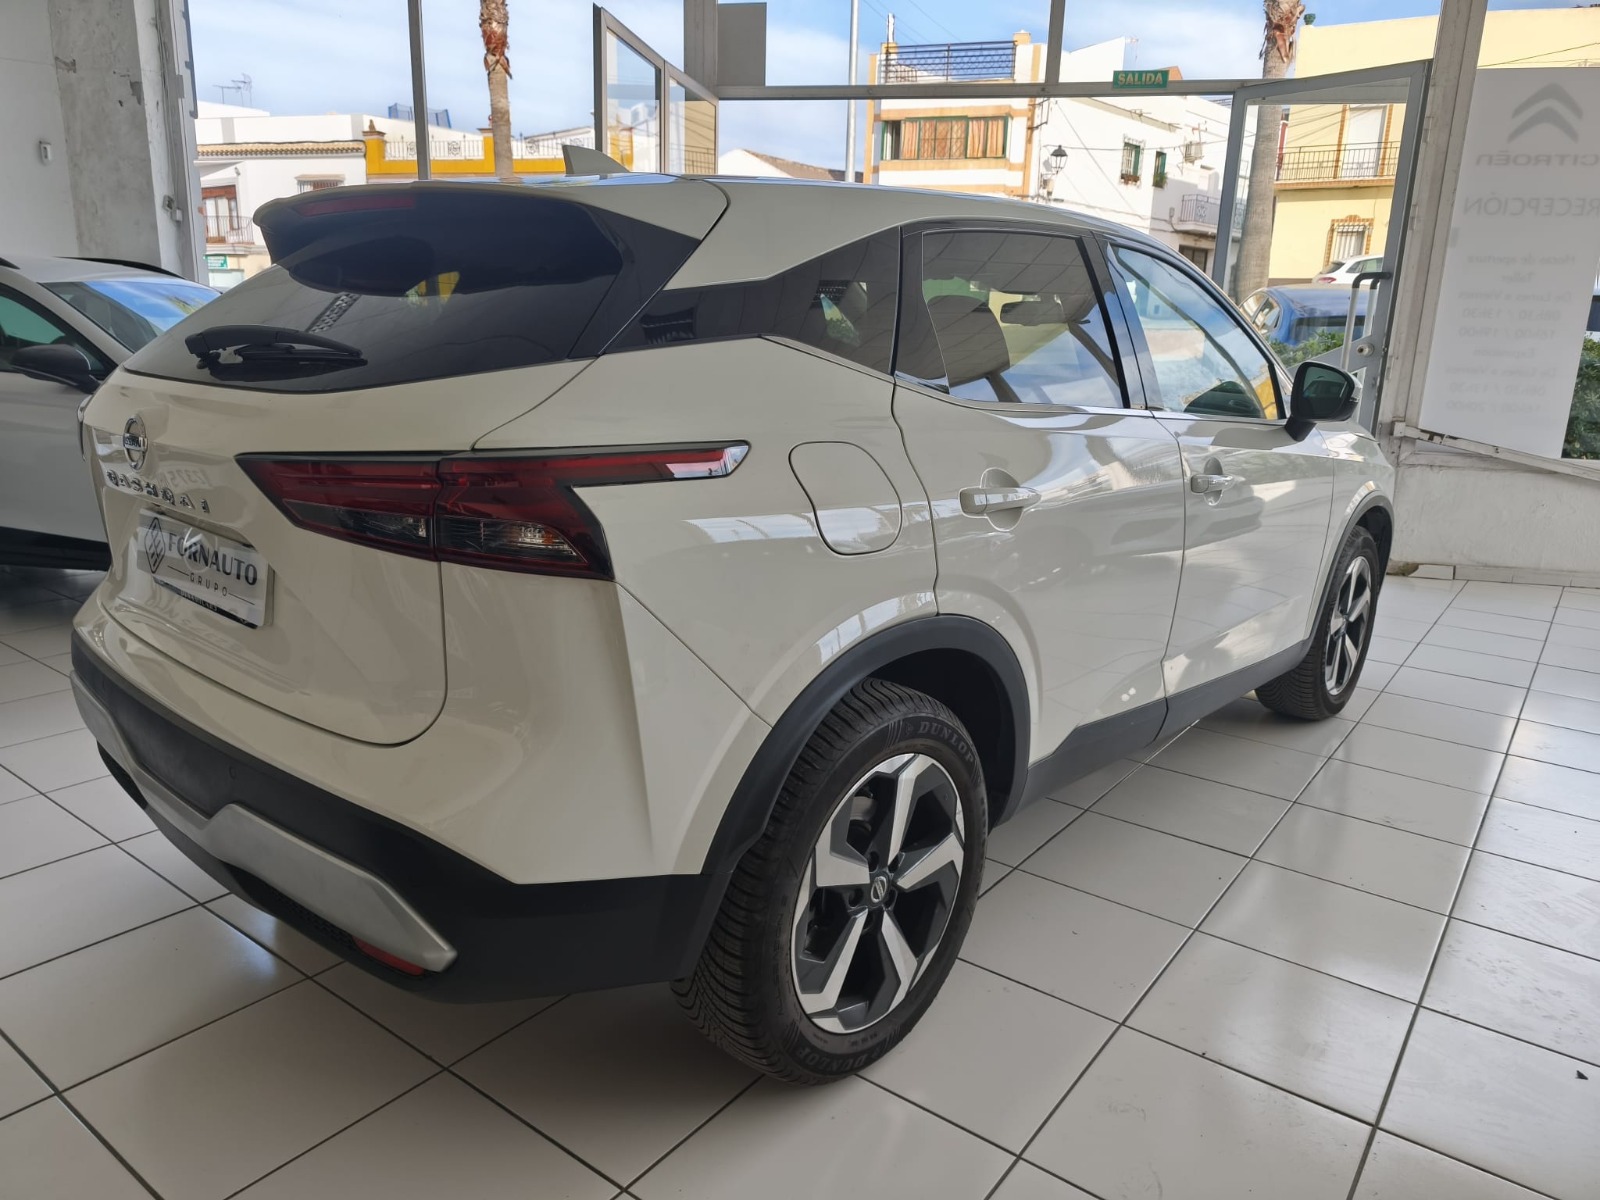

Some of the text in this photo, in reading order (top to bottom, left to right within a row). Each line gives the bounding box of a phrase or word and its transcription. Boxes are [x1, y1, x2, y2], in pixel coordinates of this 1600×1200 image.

[1118, 72, 1163, 85] SALIDA
[168, 532, 258, 586] FORNAUTO
[189, 572, 228, 597] GRUPO
[917, 720, 976, 763] DUNLOP
